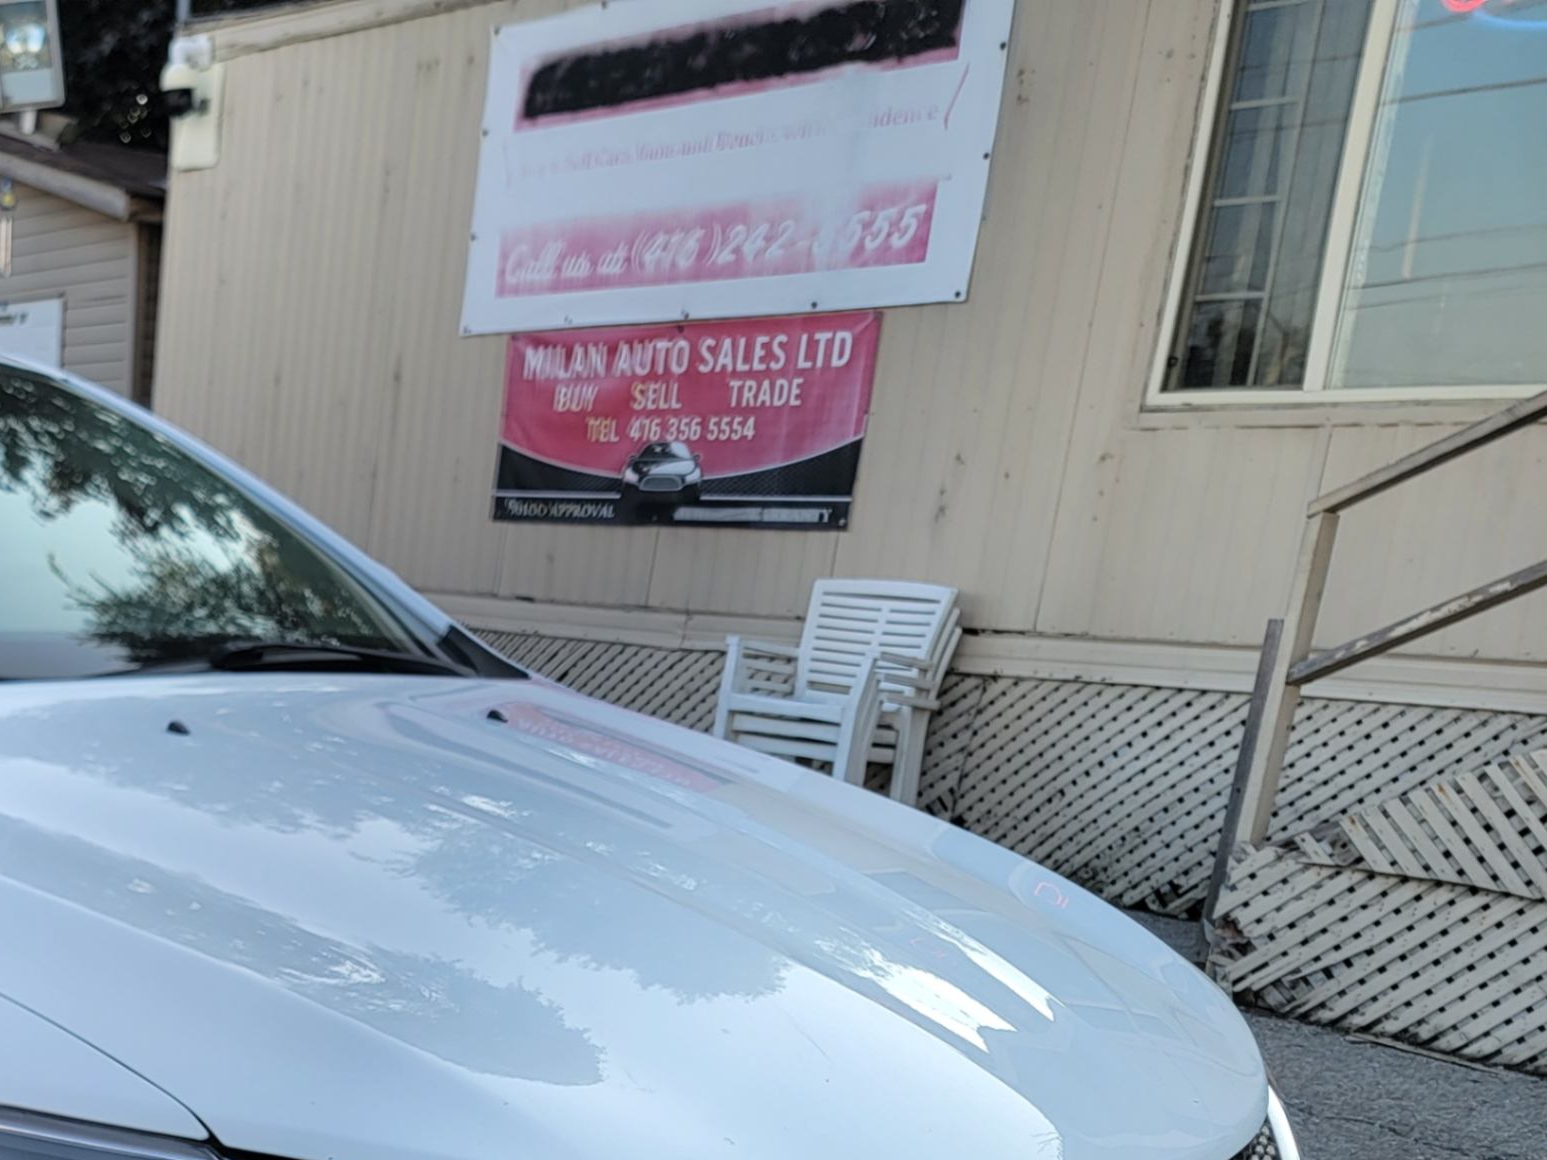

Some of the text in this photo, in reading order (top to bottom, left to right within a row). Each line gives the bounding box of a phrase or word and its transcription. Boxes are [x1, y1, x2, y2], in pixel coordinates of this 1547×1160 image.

[506, 239, 565, 281] Call
[631, 204, 928, 273] (416)242-555
[524, 331, 854, 380] MILAN AUTO SALES LTD
[553, 378, 804, 412] BUY SELL TRADE
[585, 416, 756, 442] TEL 416 356 5554
